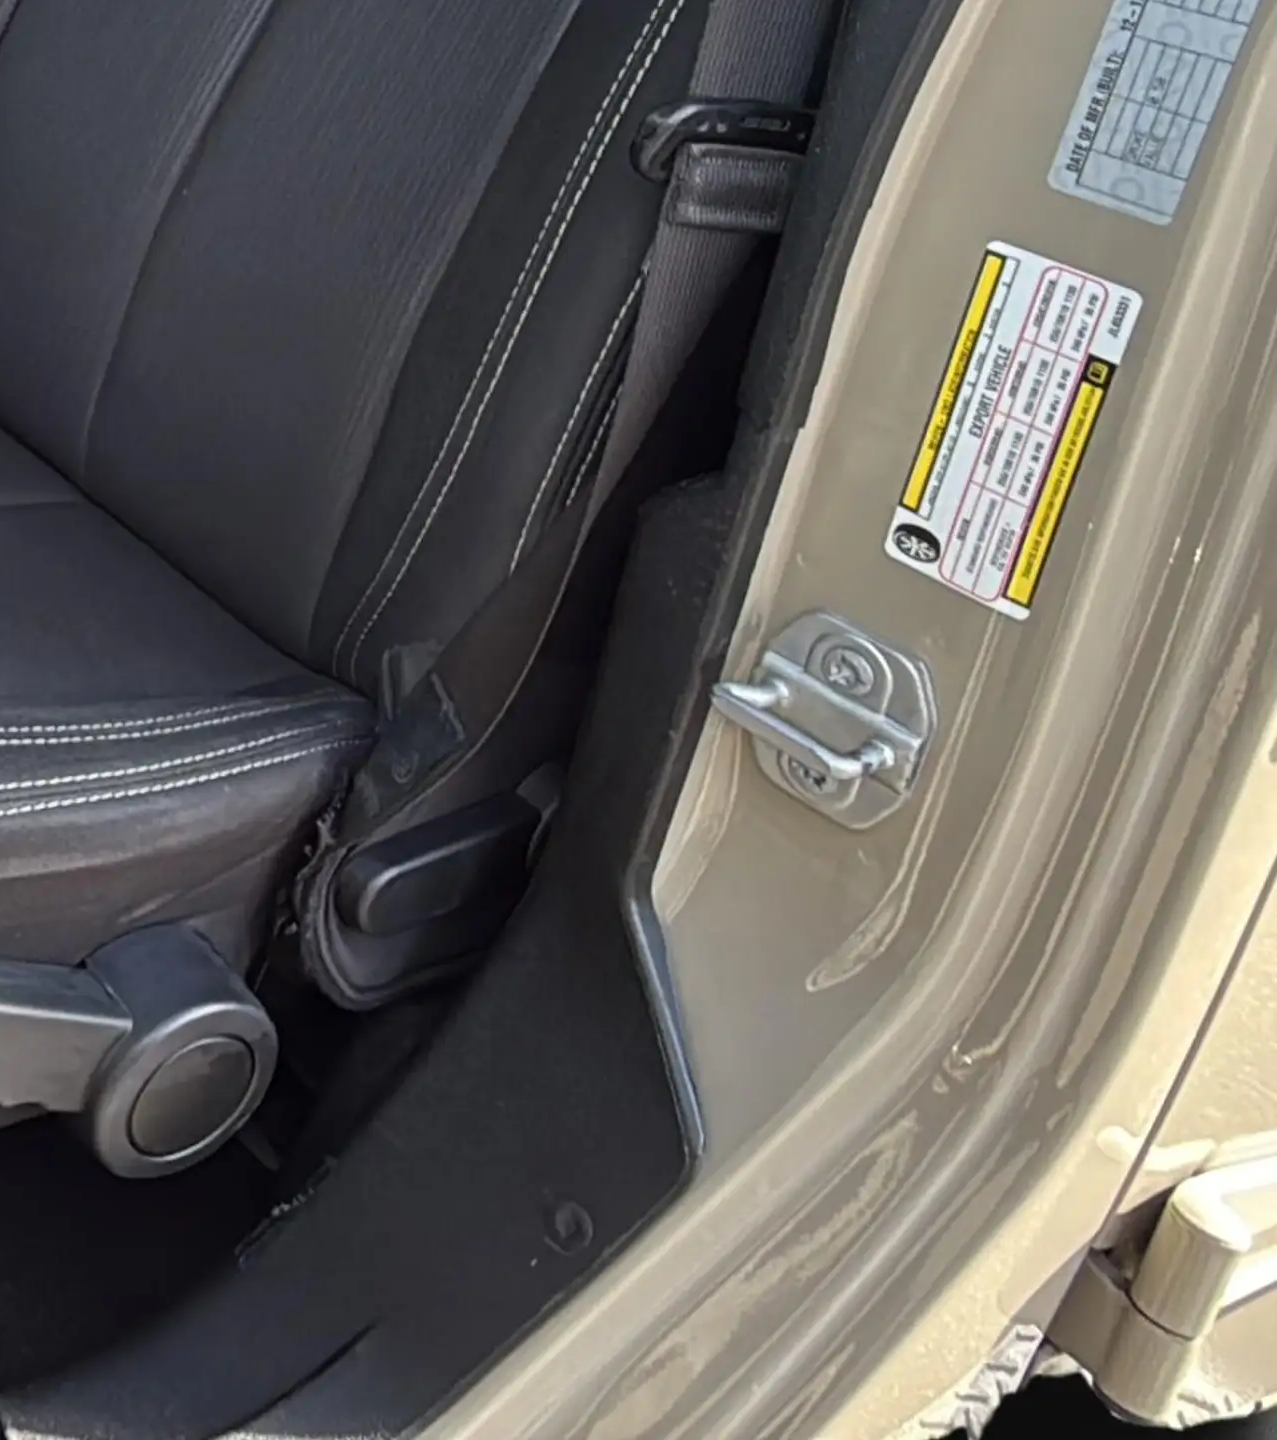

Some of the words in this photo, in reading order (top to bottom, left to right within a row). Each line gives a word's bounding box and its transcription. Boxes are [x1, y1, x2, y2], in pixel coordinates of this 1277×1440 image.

[1065, 142, 1087, 173] DATE
[1077, 125, 1095, 142] OF
[969, 394, 994, 439] EXPORT
[984, 344, 1012, 392] VEHICLE
